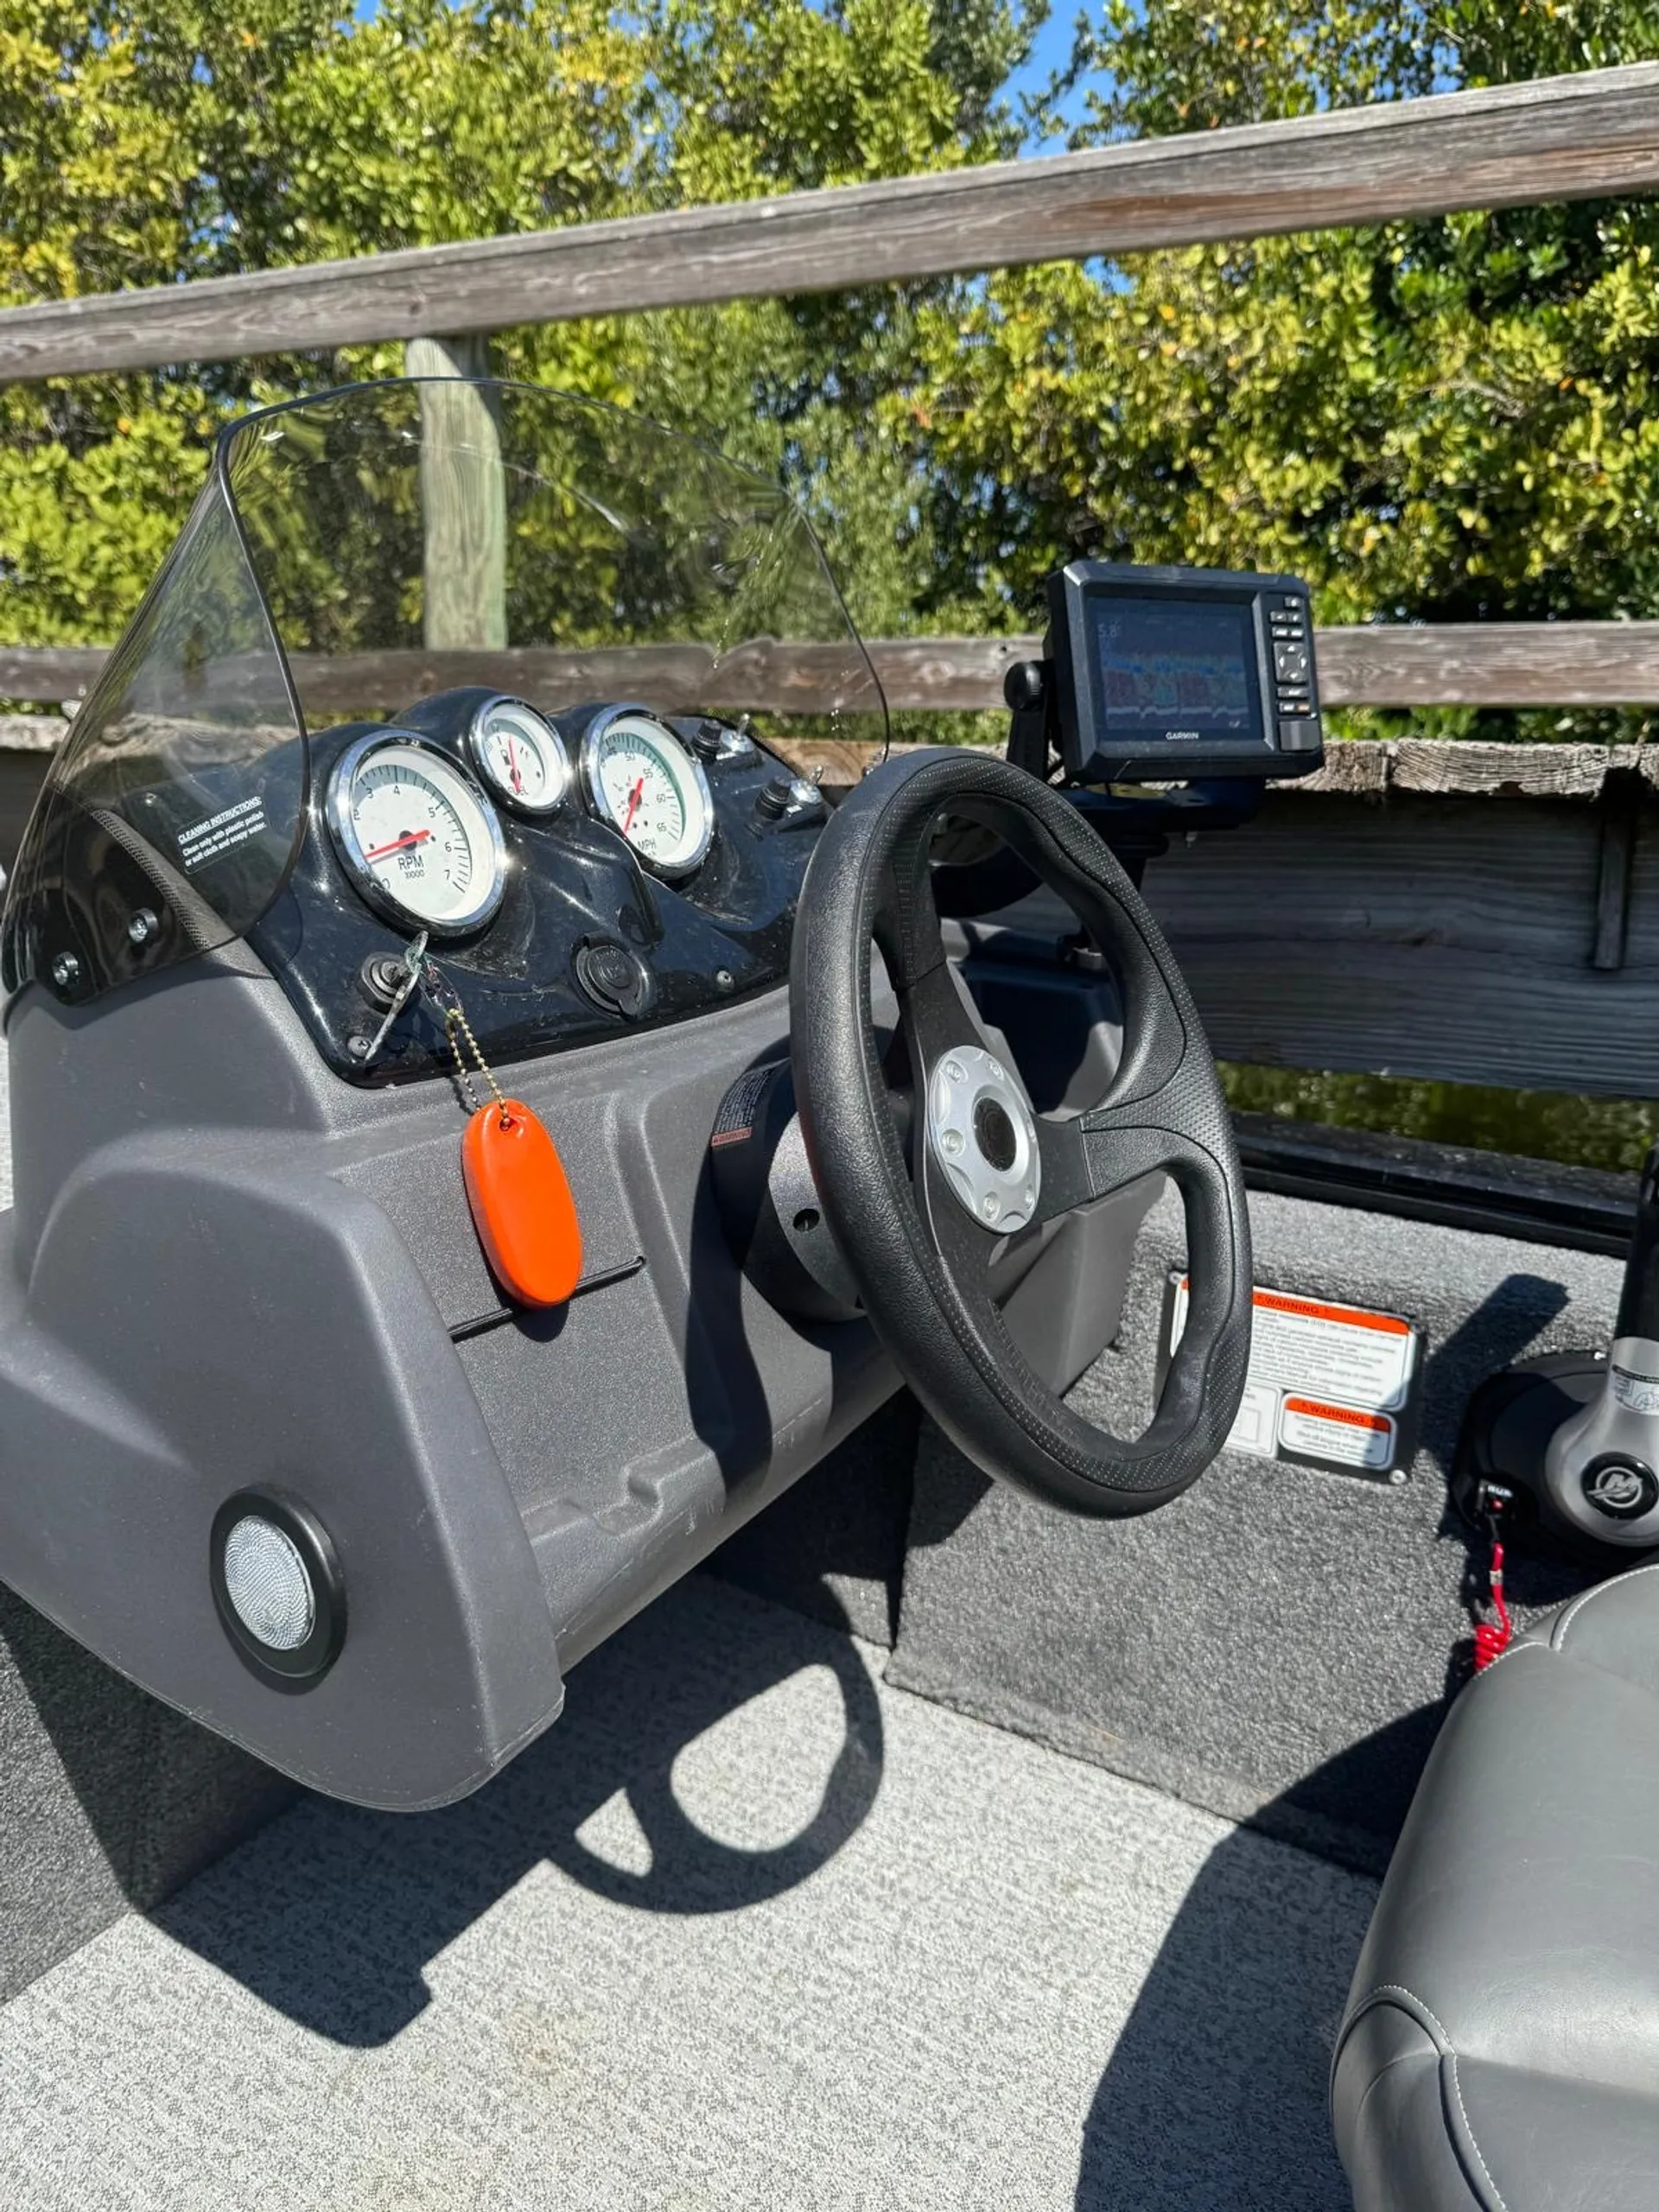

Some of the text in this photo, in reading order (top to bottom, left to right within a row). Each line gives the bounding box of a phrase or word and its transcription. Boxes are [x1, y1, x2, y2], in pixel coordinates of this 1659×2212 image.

[1165, 731, 1199, 740] GARMIN
[643, 768, 653, 779] 55
[366, 786, 374, 799] 3
[393, 785, 401, 795] 4
[657, 793, 666, 803] 60
[353, 810, 361, 821] 2
[428, 807, 435, 818] 5
[178, 820, 213, 844] CLEANING
[445, 842, 452, 853] 6
[637, 837, 657, 851] MPH
[397, 855, 424, 870] RPM
[444, 869, 450, 880] 7
[1264, 1297, 1319, 1313] WARNING
[1310, 1405, 1364, 1424] WARNING
